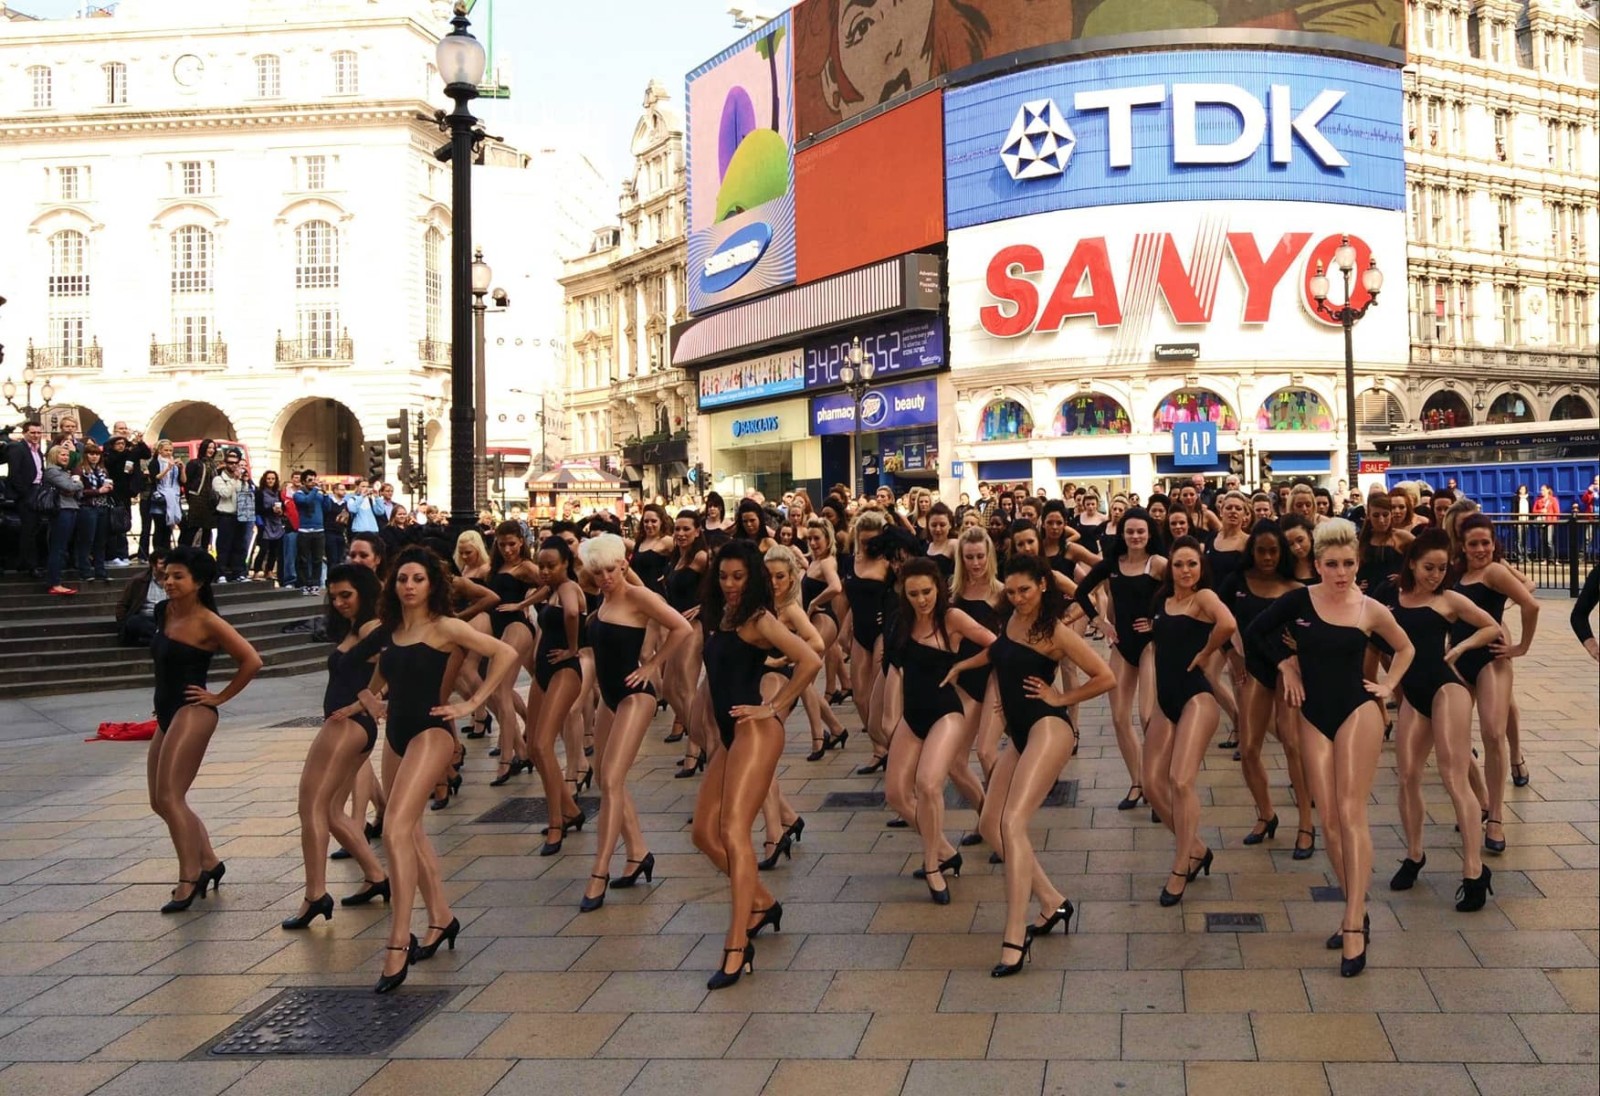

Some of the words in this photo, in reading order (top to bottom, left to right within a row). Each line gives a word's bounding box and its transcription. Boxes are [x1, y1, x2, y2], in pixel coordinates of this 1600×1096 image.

[1074, 83, 1350, 168] TDK
[979, 233, 1374, 338] SANYO
[894, 394, 925, 412] beauty
[817, 406, 856, 425] pharmacy
[740, 416, 779, 436] BARCLAYS
[1180, 431, 1211, 456] GAP
[1460, 440, 1484, 448] POLICE
[1495, 438, 1520, 446] POLICE
[1569, 434, 1595, 442] POLICE
[1365, 463, 1384, 473] SALE
